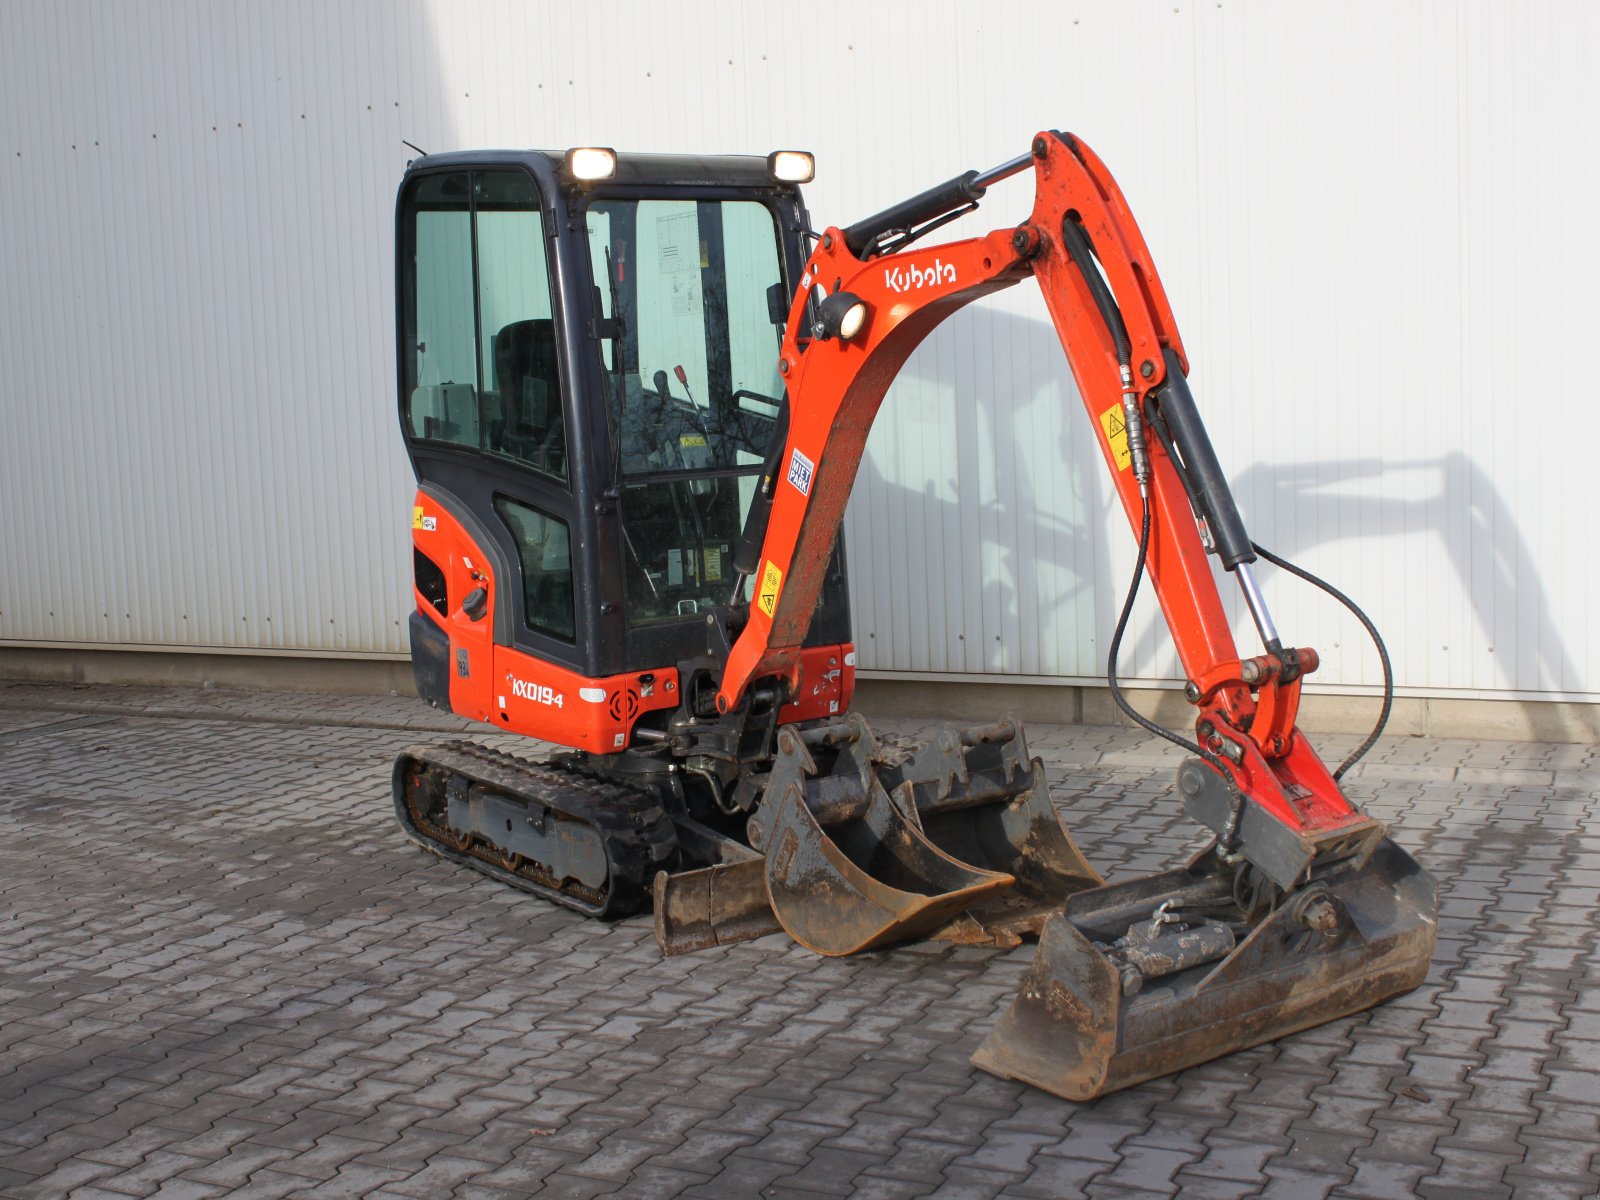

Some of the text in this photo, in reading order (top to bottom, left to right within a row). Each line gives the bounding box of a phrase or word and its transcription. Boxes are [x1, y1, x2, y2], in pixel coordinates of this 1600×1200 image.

[885, 258, 956, 293] Kubota
[790, 470, 808, 493] PARK
[792, 460, 810, 481] MIET
[512, 678, 563, 708] KX019-4
